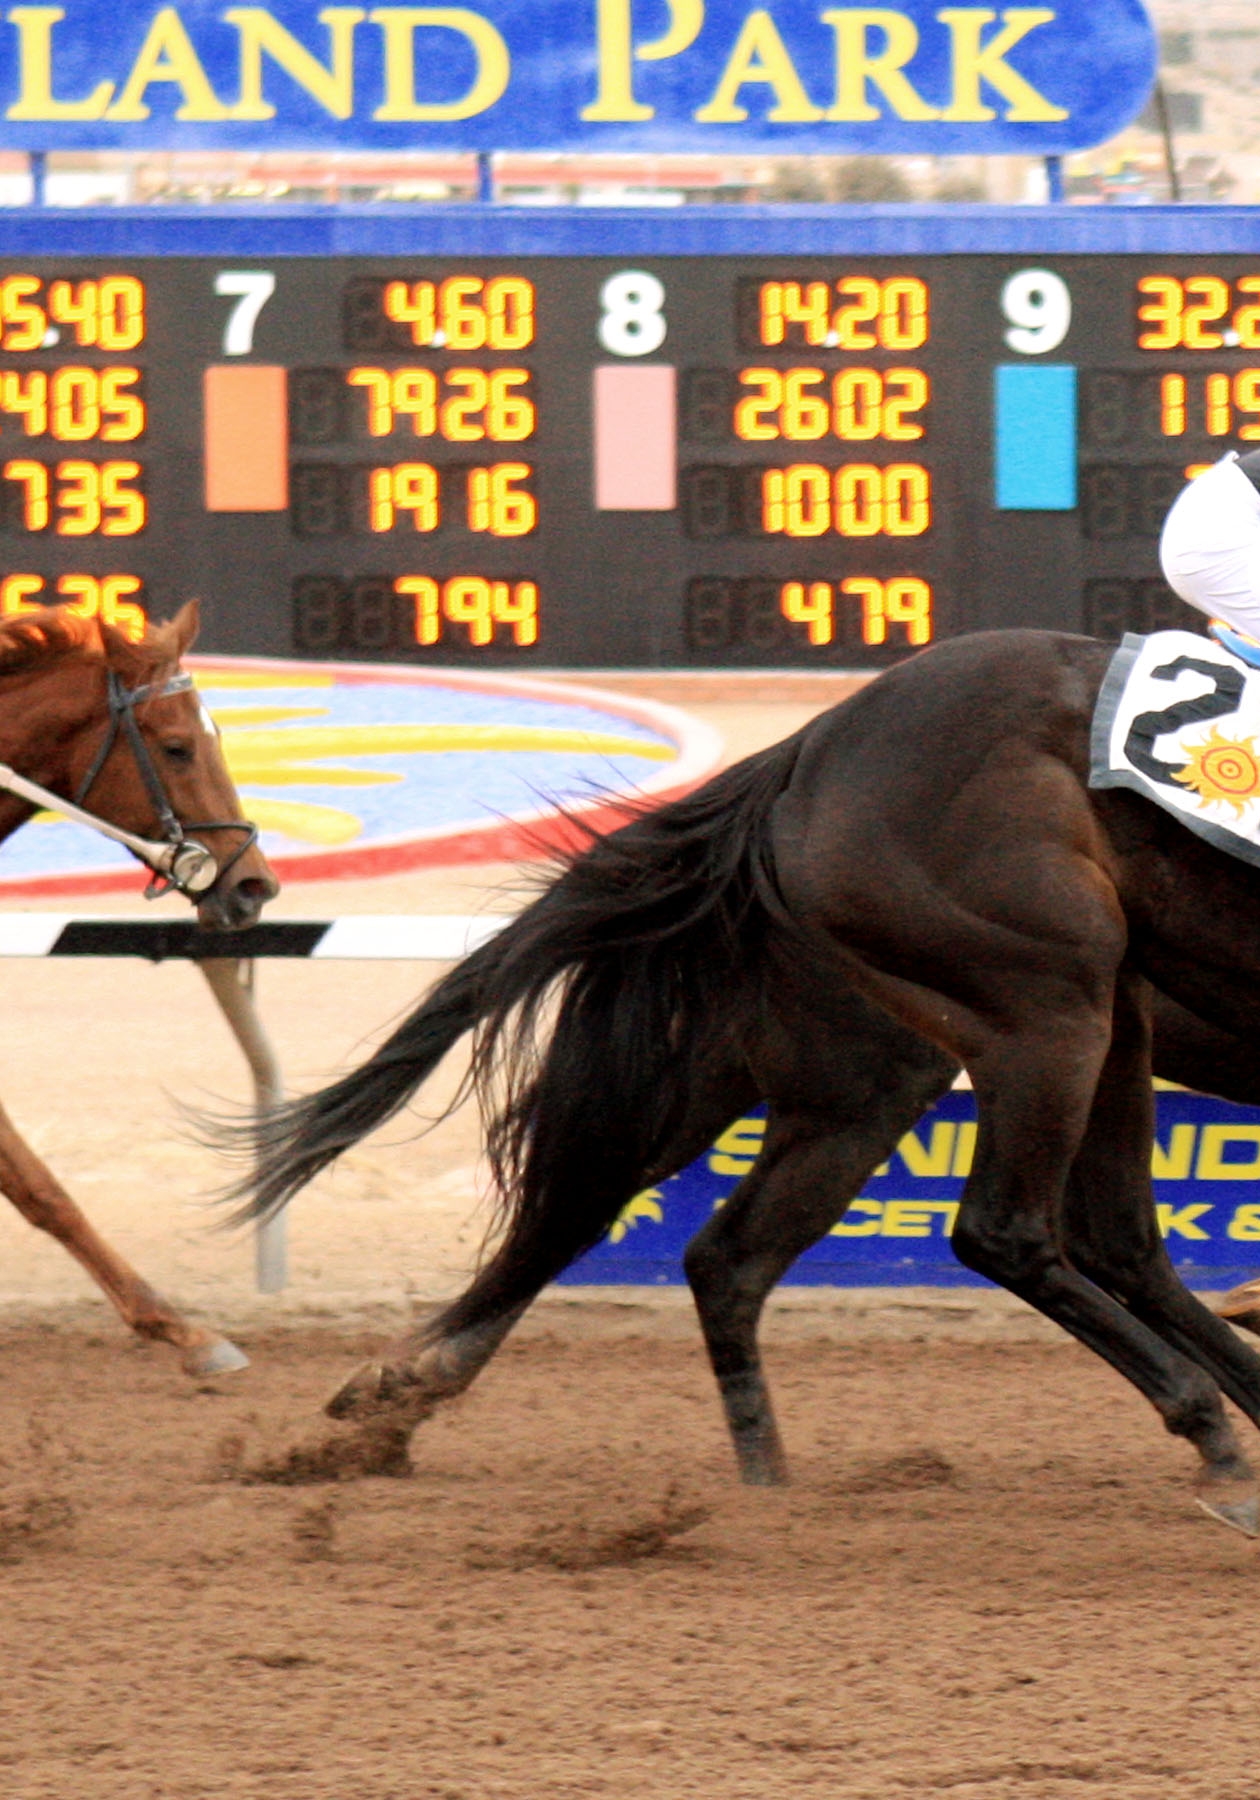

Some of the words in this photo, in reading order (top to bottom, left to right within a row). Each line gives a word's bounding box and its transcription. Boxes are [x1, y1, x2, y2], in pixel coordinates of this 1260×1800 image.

[6, 8, 510, 121] LAND
[580, 0, 1068, 122] PARK
[0, 274, 146, 351] 5.40
[214, 270, 275, 356] 7
[384, 275, 535, 351] 4.60
[599, 270, 667, 357] 8
[759, 275, 930, 351] 14.20
[1001, 269, 1071, 355] 9
[0, 365, 146, 441] 405
[347, 366, 535, 441] 7926
[733, 366, 930, 441] 2602
[3, 460, 146, 536] 735
[762, 462, 930, 537] 1000
[394, 575, 538, 646] 794
[780, 576, 932, 646] 479
[1123, 654, 1247, 793] 2
